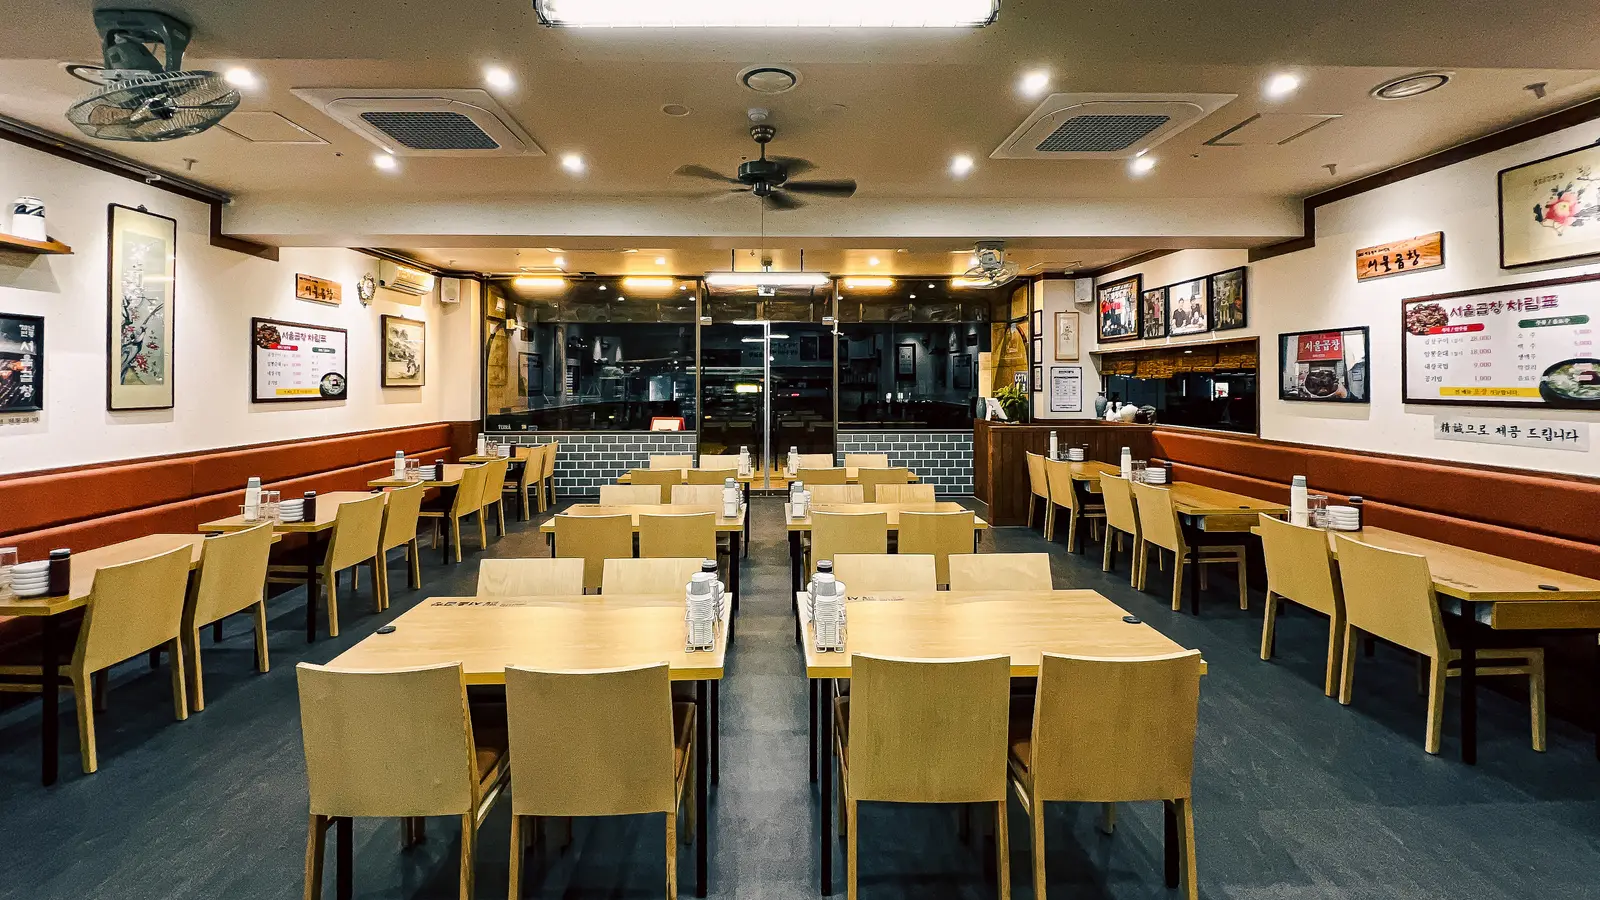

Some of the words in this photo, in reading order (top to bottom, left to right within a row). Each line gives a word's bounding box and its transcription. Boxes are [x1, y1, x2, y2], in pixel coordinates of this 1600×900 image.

[1450, 301, 1504, 318] 서울곱창
[1506, 295, 1559, 312] 차림표
[1304, 339, 1341, 352] 서울곱창
[19, 340, 35, 397] 서울곱창
[1495, 425, 1521, 439] 제공
[1526, 427, 1579, 442] 드립니다
